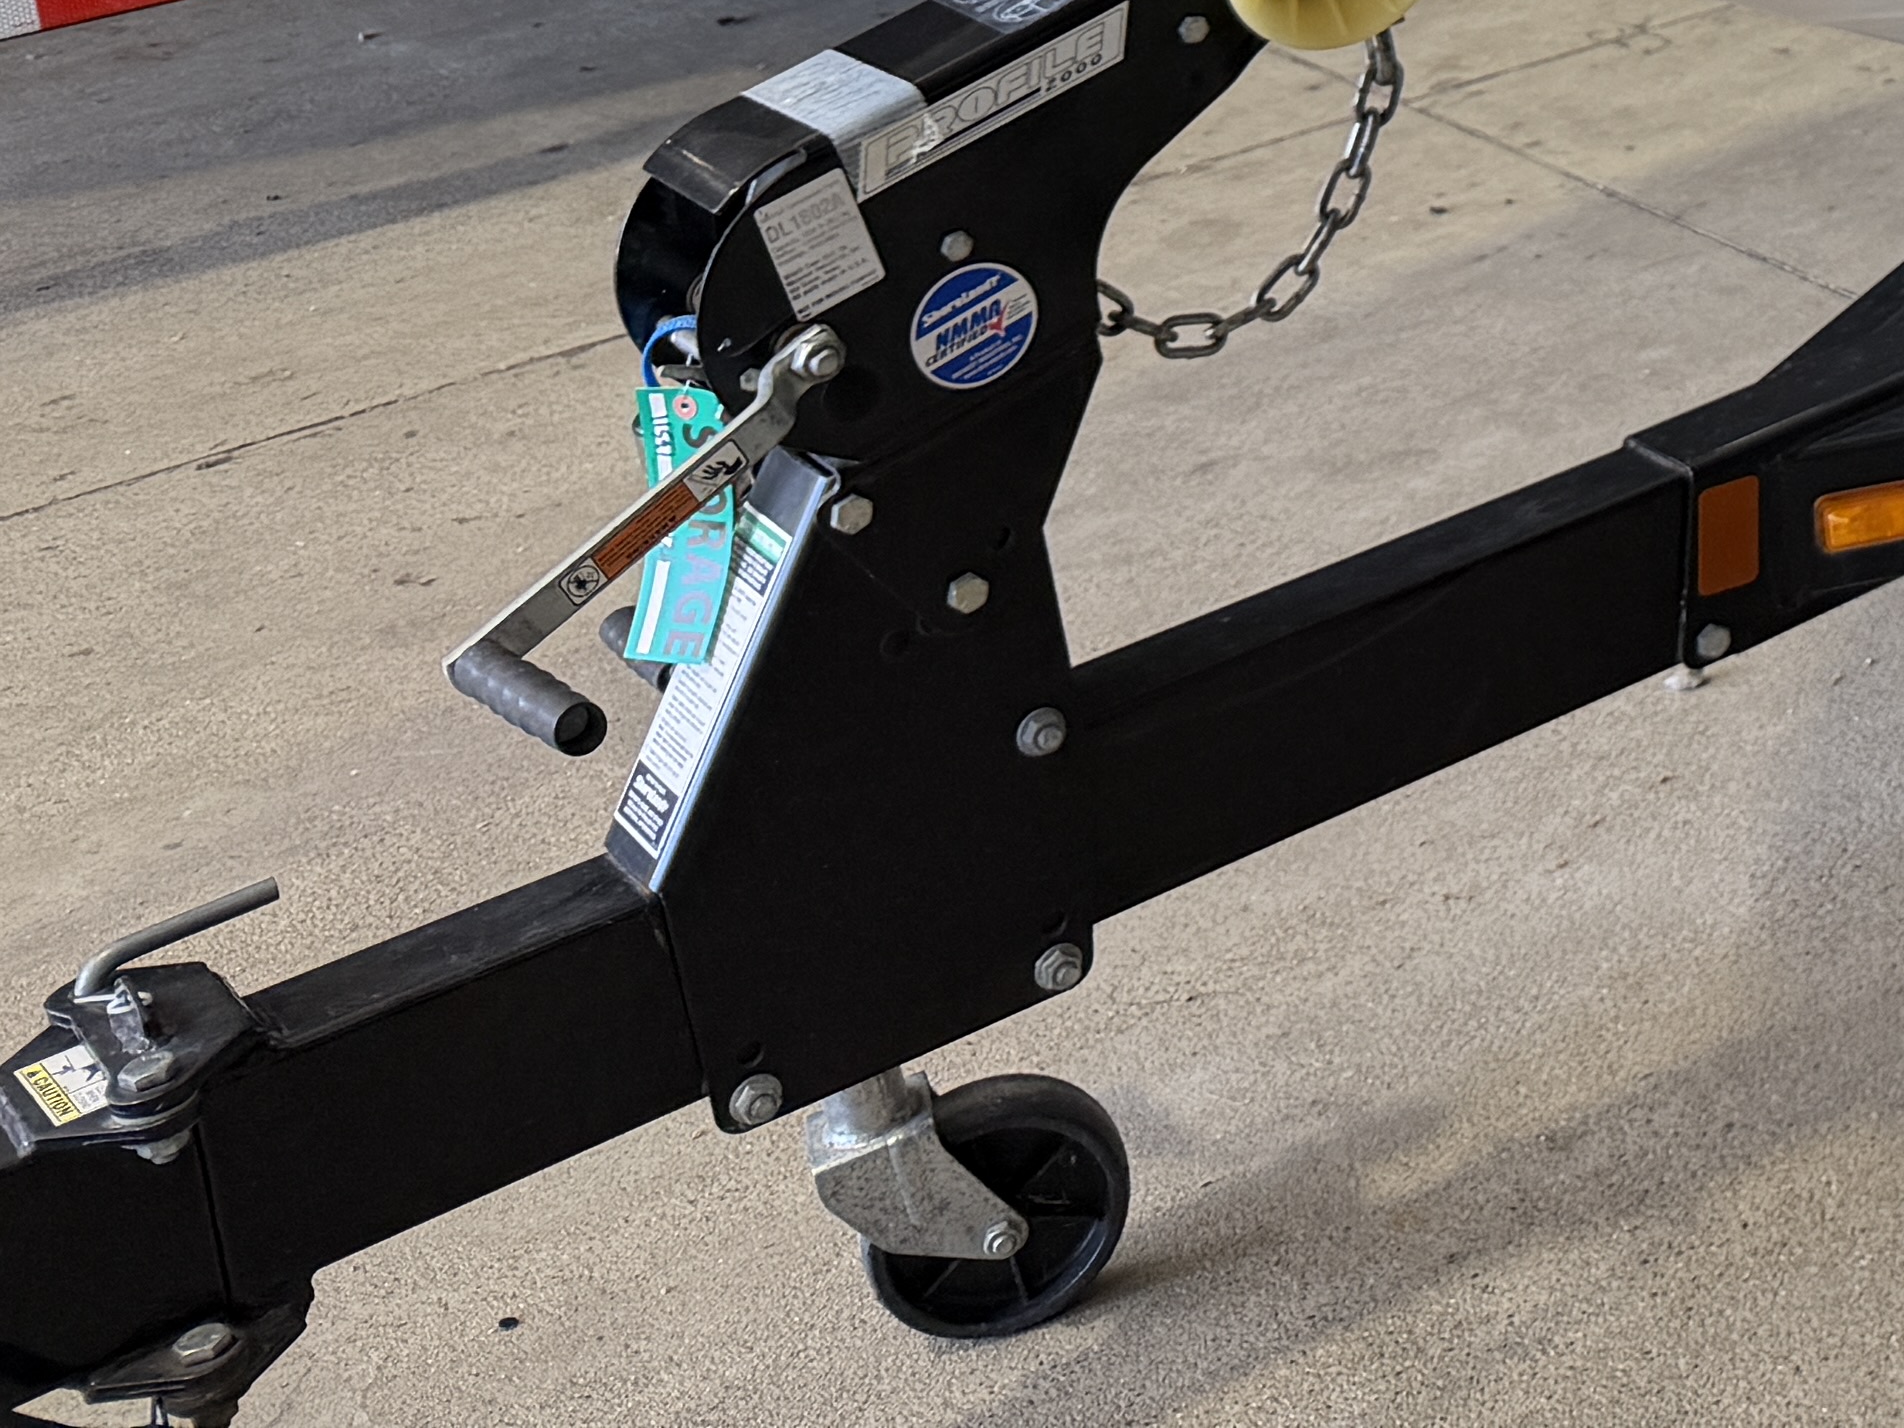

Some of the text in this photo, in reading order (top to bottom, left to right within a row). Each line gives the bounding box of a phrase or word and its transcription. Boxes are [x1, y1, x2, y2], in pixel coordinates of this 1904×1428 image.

[883, 21, 1106, 169] PROFILE
[1044, 52, 1104, 94] 2000
[662, 422, 729, 660] SORAGE
[33, 1076, 74, 1117] CAUTION
